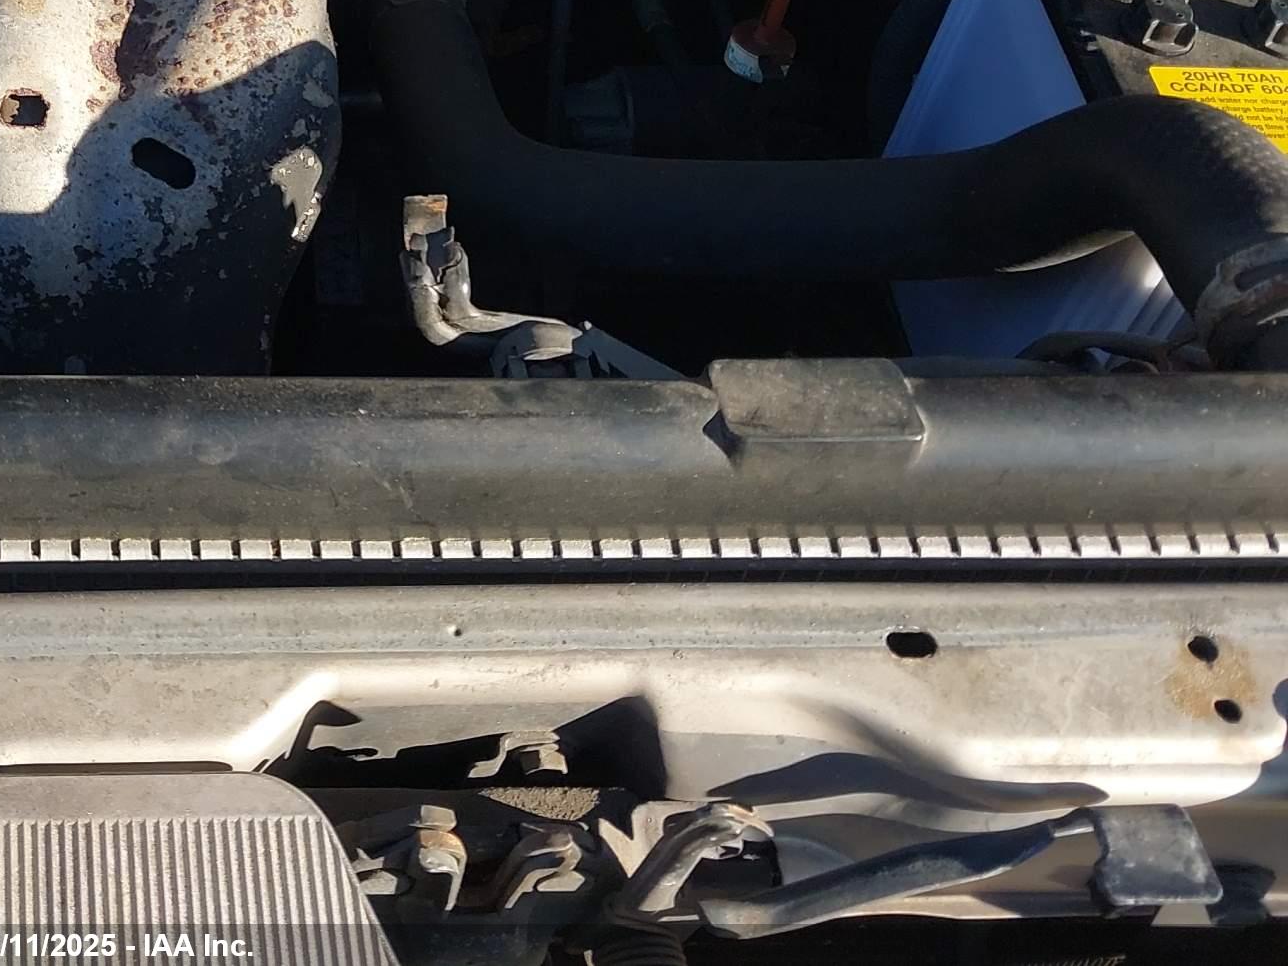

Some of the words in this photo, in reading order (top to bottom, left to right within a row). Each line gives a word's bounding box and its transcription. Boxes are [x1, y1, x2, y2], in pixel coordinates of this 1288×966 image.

[1183, 71, 1232, 82] 20HR
[1236, 73, 1283, 83] 70Ah
[1170, 82, 1255, 93] CCA/ADF
